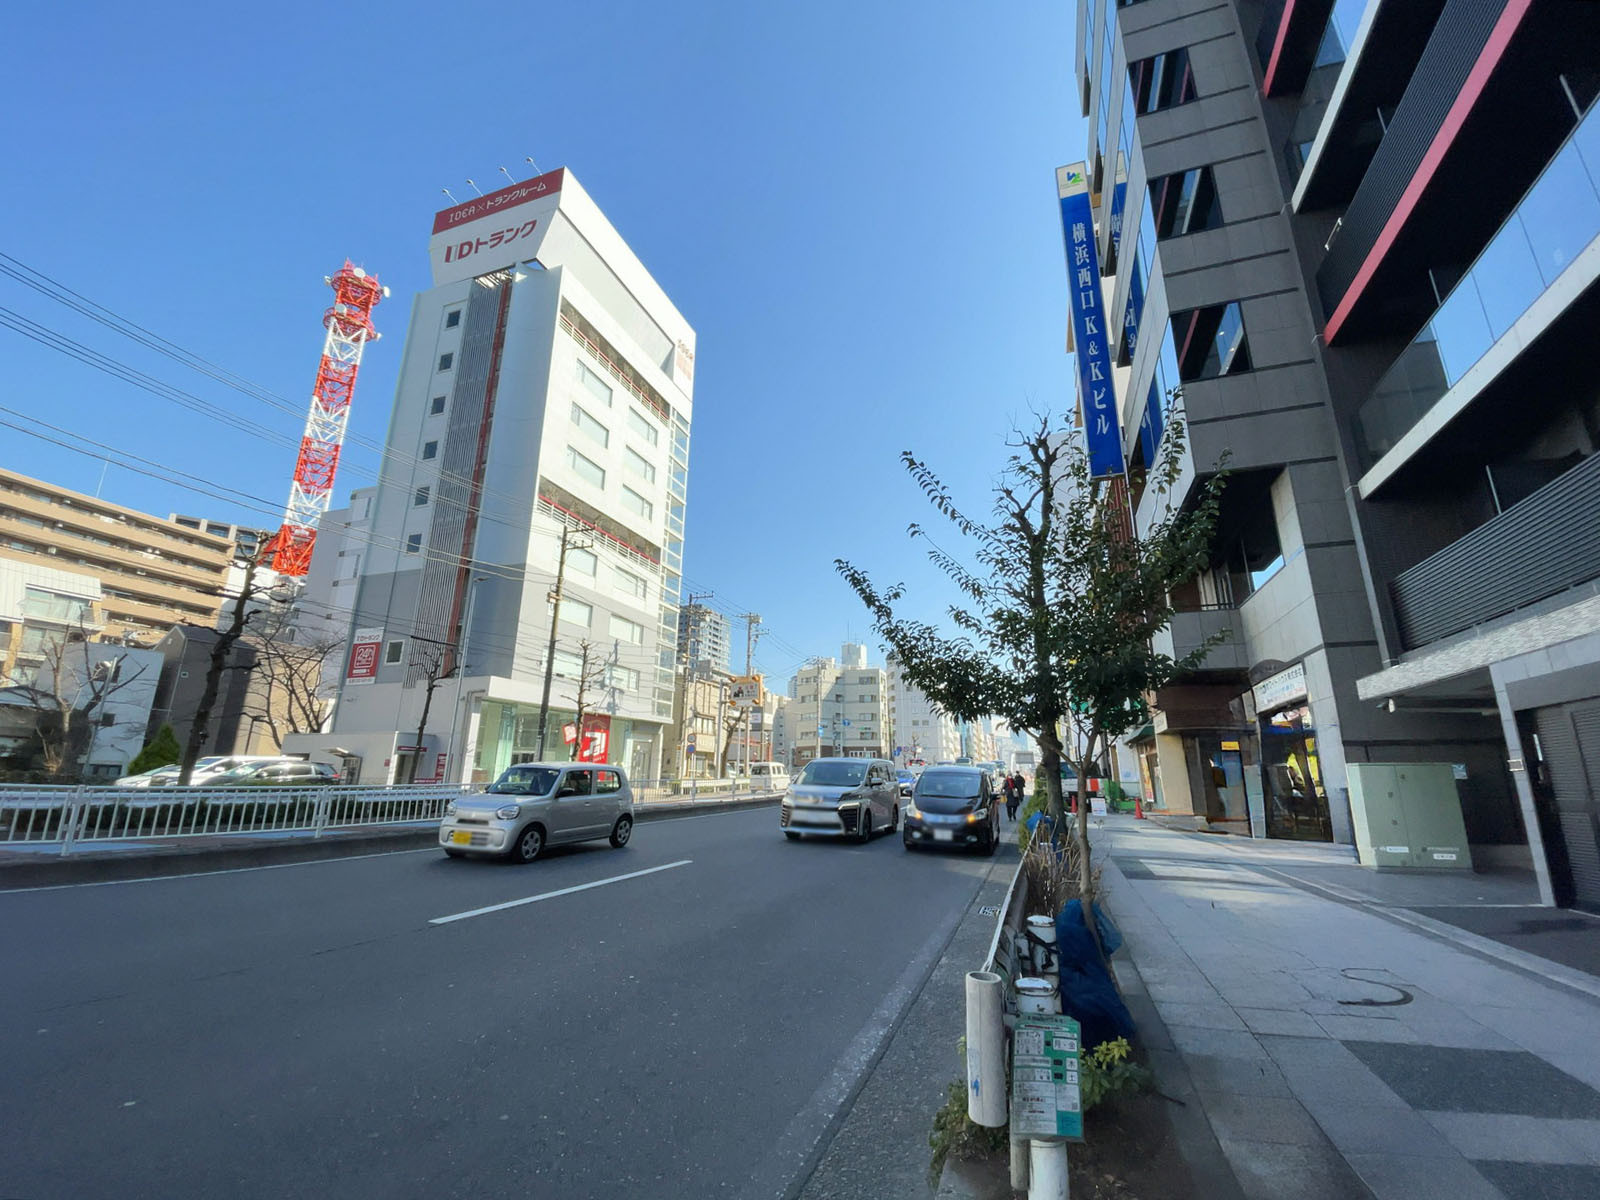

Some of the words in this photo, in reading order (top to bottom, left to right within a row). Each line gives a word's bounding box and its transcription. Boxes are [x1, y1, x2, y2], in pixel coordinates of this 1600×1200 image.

[1072, 223, 1109, 435] 横浜西口K&Kビル
